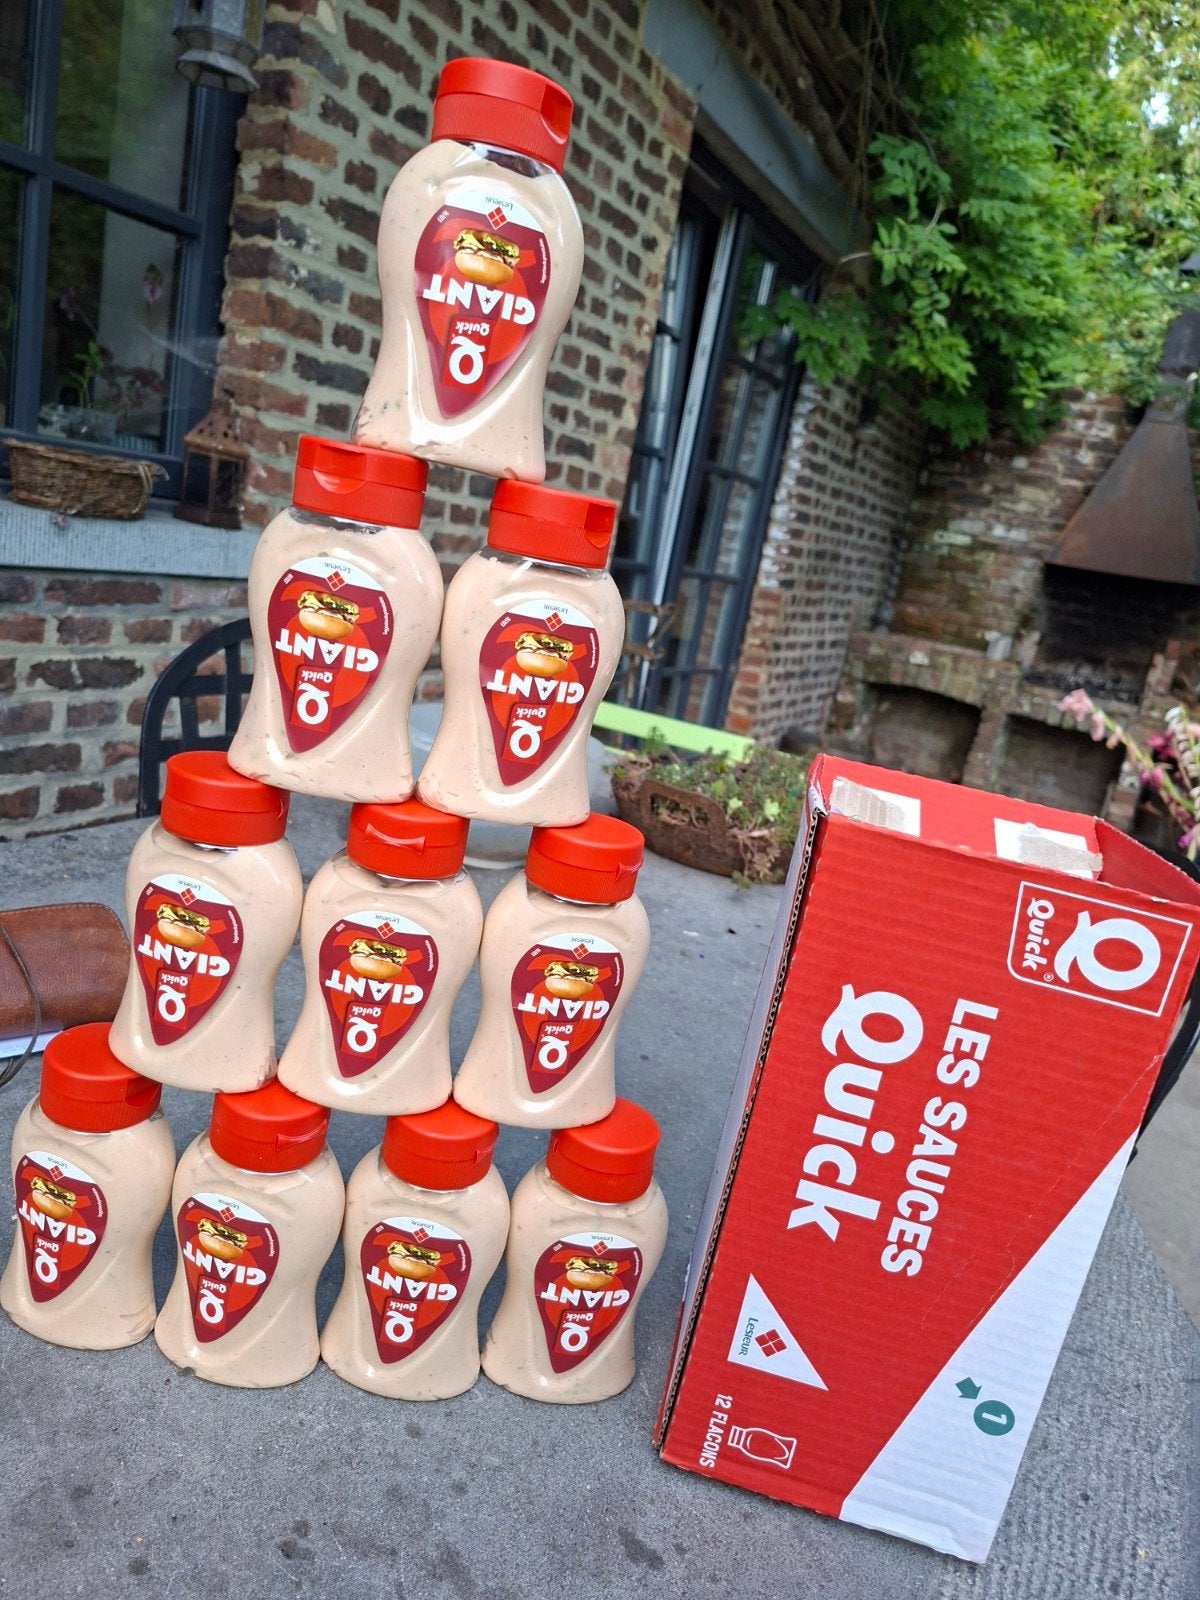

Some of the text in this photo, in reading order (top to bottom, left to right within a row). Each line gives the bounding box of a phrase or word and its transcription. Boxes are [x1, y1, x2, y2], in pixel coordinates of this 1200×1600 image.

[423, 274, 535, 325] GIANT
[456, 321, 490, 337] Quick
[449, 336, 486, 384] Q
[275, 628, 379, 672] GIANT
[302, 670, 333, 683] Quick
[487, 669, 584, 704] GIANT
[297, 683, 330, 724] Q
[516, 707, 546, 718] Quick
[510, 720, 542, 759] Q
[1022, 897, 1055, 971] Quick
[1054, 910, 1161, 991] Q
[138, 934, 230, 976] GIANT
[162, 973, 188, 986] Quick
[325, 969, 423, 1005] GIANT
[158, 985, 186, 1022] Q
[352, 1005, 381, 1016] Quick
[518, 992, 610, 1019] GIANT
[347, 1017, 378, 1052] Q
[545, 1025, 573, 1034] Quick
[538, 1035, 569, 1069] Q
[786, 983, 924, 1242] Quick
[880, 998, 999, 1277] LES SAUCES
[19, 1200, 96, 1245] GIANT
[37, 1238, 59, 1252] Quick
[35, 1248, 58, 1283] Q
[183, 1241, 266, 1285] GIANT
[202, 1279, 226, 1293] Quick
[367, 1266, 457, 1300] GIANT
[541, 1283, 630, 1308] GIANT
[200, 1289, 224, 1324] Q
[390, 1301, 417, 1311] Quick
[566, 1313, 593, 1322] Quick
[385, 1311, 414, 1343] Q
[561, 1322, 590, 1352] Q
[699, 1393, 733, 1468] 12 FLACONS
[982, 1412, 1008, 1425] 1
